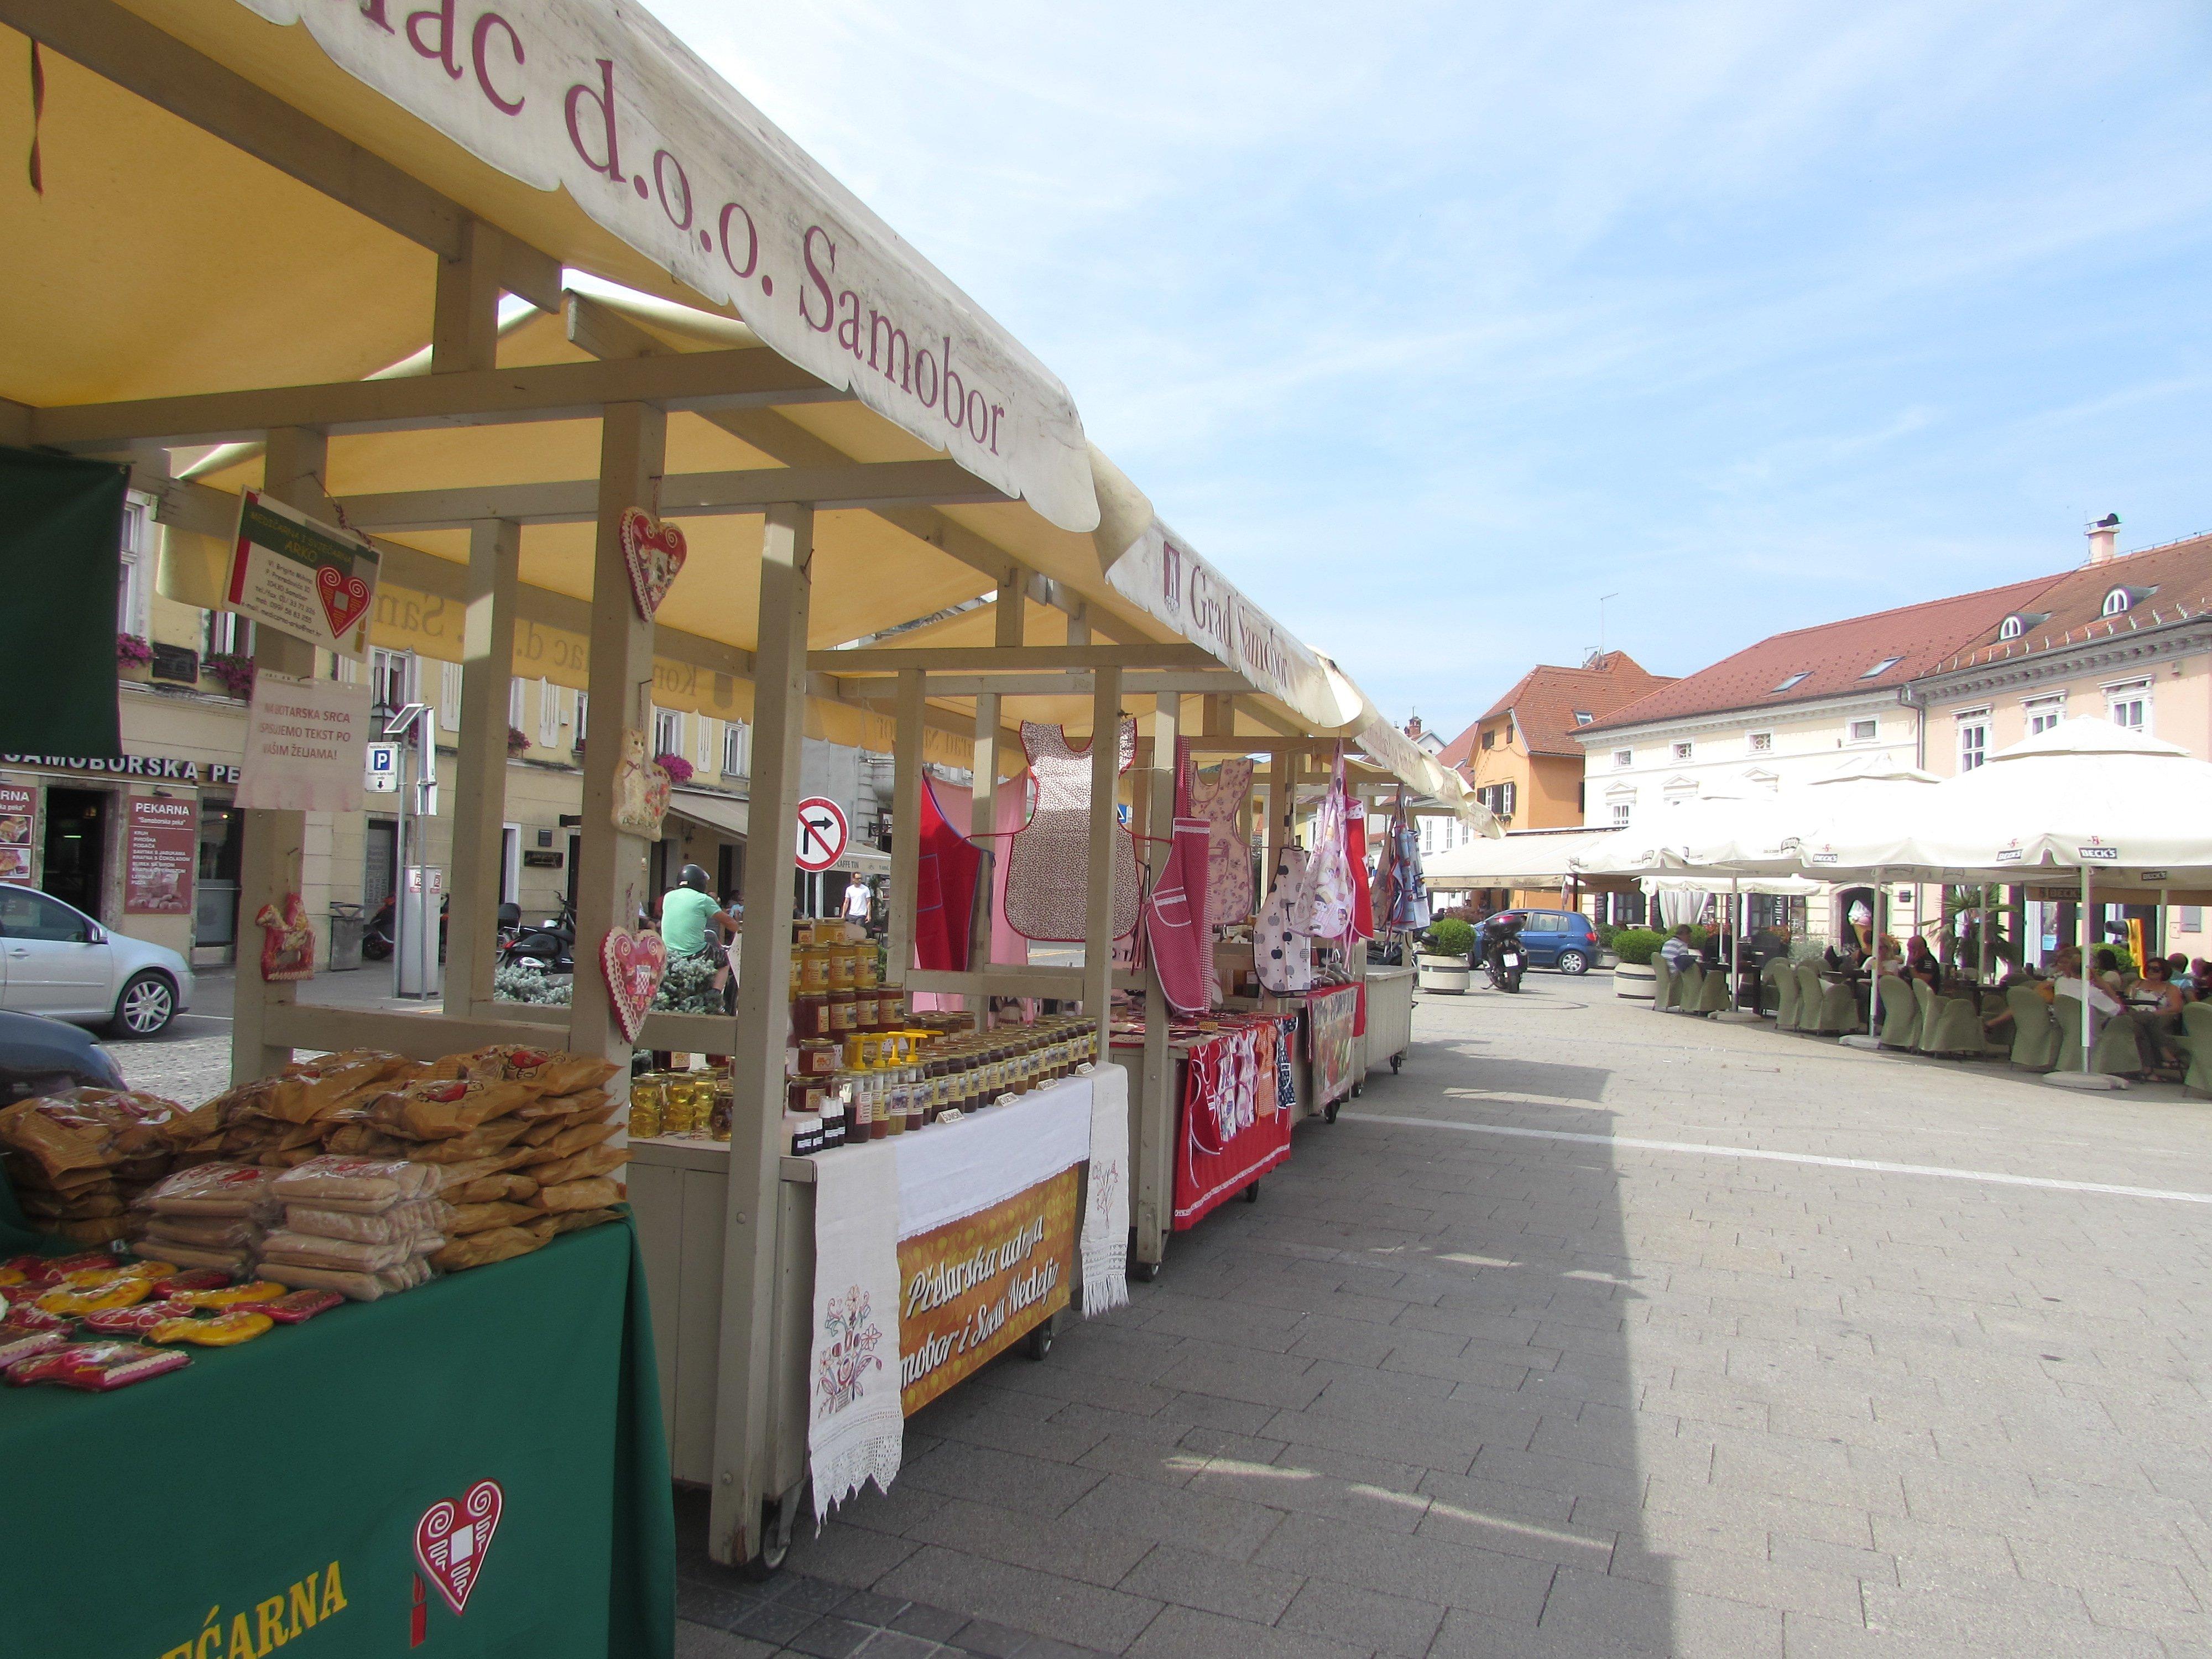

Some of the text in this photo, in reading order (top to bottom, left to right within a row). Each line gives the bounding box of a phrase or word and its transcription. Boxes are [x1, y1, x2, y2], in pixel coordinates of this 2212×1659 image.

[564, 59, 773, 296] d.o.o.
[799, 226, 1005, 455] Samobor
[284, 539, 317, 562] ARKO
[1190, 566, 1288, 688] Grad Samobor
[324, 711, 351, 723] SRCA
[305, 728, 334, 740] TEKST
[336, 732, 351, 742] PO
[377, 753, 388, 769] P
[1, 790, 30, 802] RNA
[135, 802, 191, 816] PEKARNA
[1813, 854, 1837, 863] BECK'S
[1998, 851, 2022, 860] BECK'S
[2081, 848, 2116, 858] BECK'S
[905, 1245, 998, 1319] Pčelarska
[900, 1256, 1060, 1391] mobor i Sveta Nedelja
